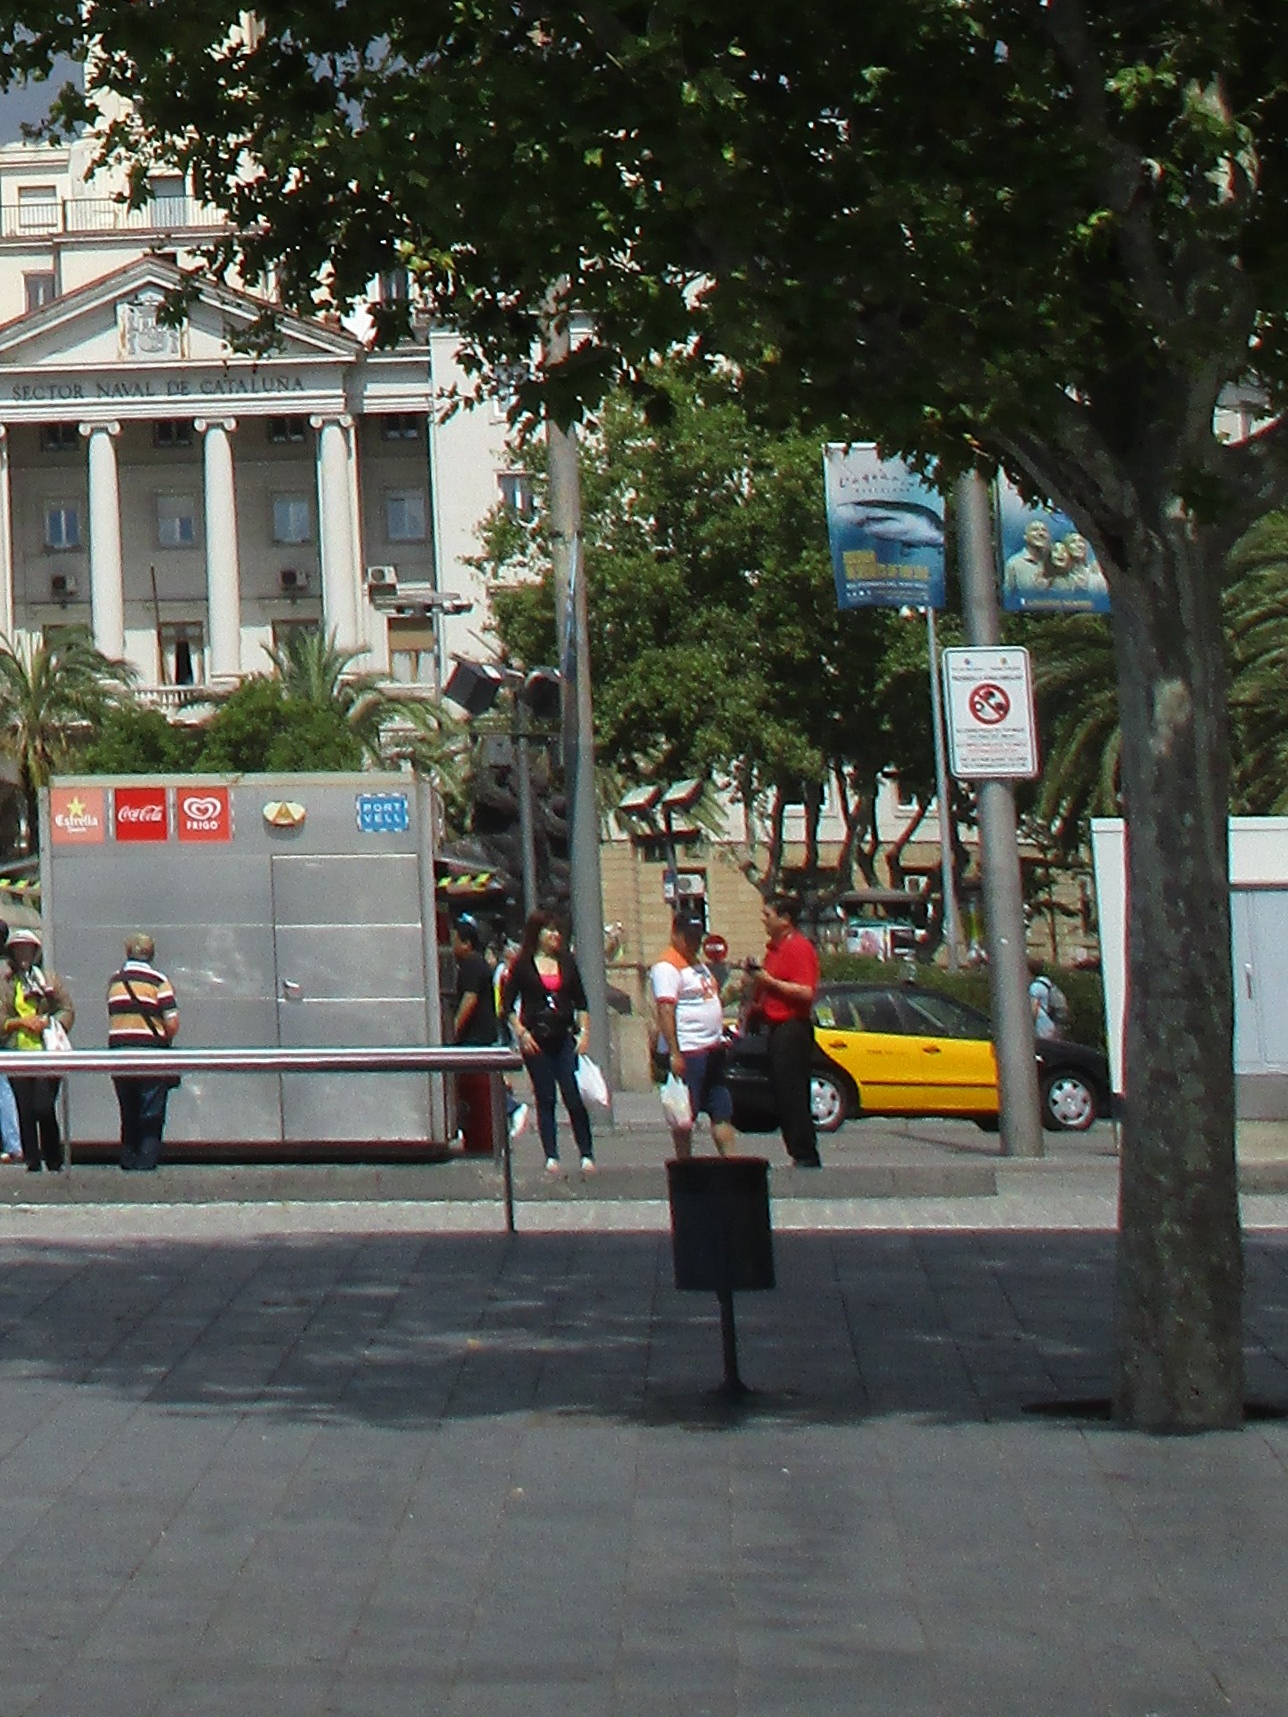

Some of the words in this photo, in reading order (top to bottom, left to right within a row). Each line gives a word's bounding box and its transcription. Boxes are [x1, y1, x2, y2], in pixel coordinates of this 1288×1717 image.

[12, 384, 84, 401] SECTOR
[97, 380, 152, 399] NAVAL
[167, 380, 191, 396] DE
[199, 375, 304, 395] CATALUÑA
[362, 802, 403, 813] PORT
[55, 813, 99, 827] Estrella
[362, 813, 402, 823] VELL
[186, 820, 219, 830] FRIGO
